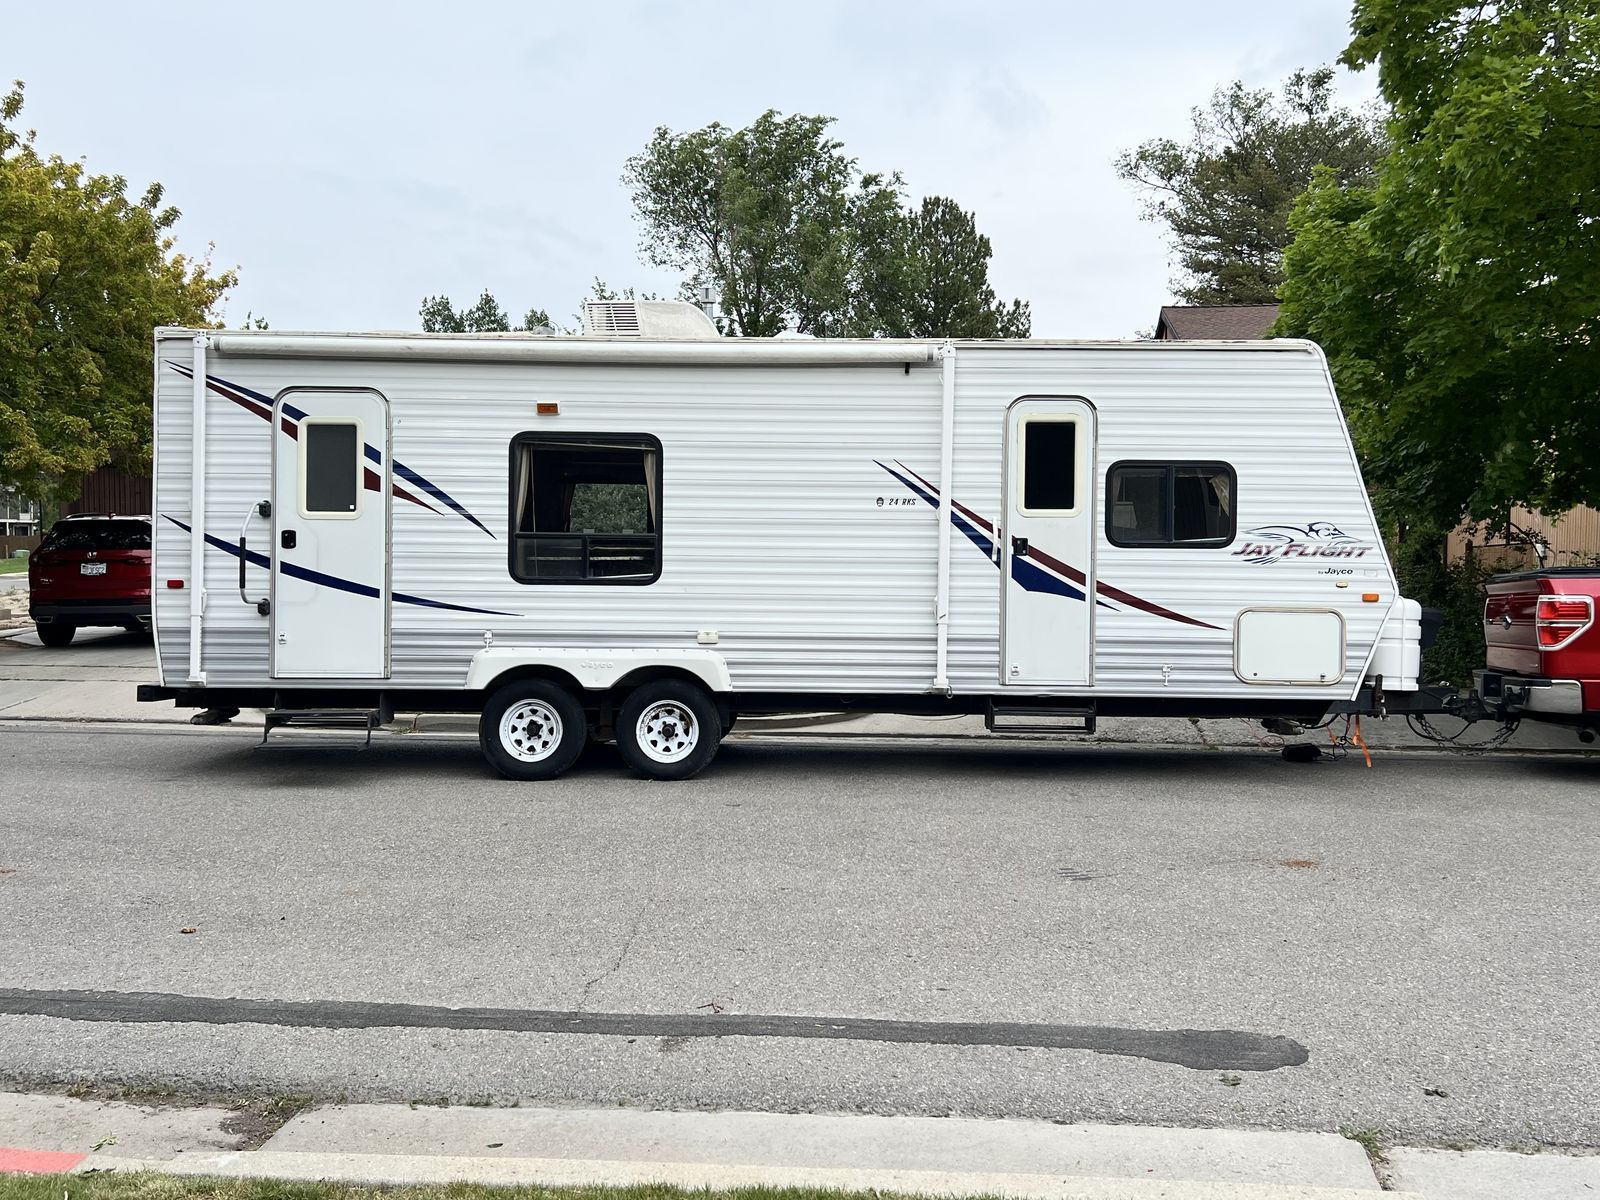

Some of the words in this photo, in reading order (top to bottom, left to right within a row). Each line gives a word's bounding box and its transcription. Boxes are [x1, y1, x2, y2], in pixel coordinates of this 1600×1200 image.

[889, 498, 899, 506] 24
[902, 498, 916, 506] RKS
[1231, 543, 1281, 556] JAY
[1281, 543, 1373, 558] FLIGHT
[1324, 567, 1353, 575] Jayco
[580, 659, 614, 670] Jayco
